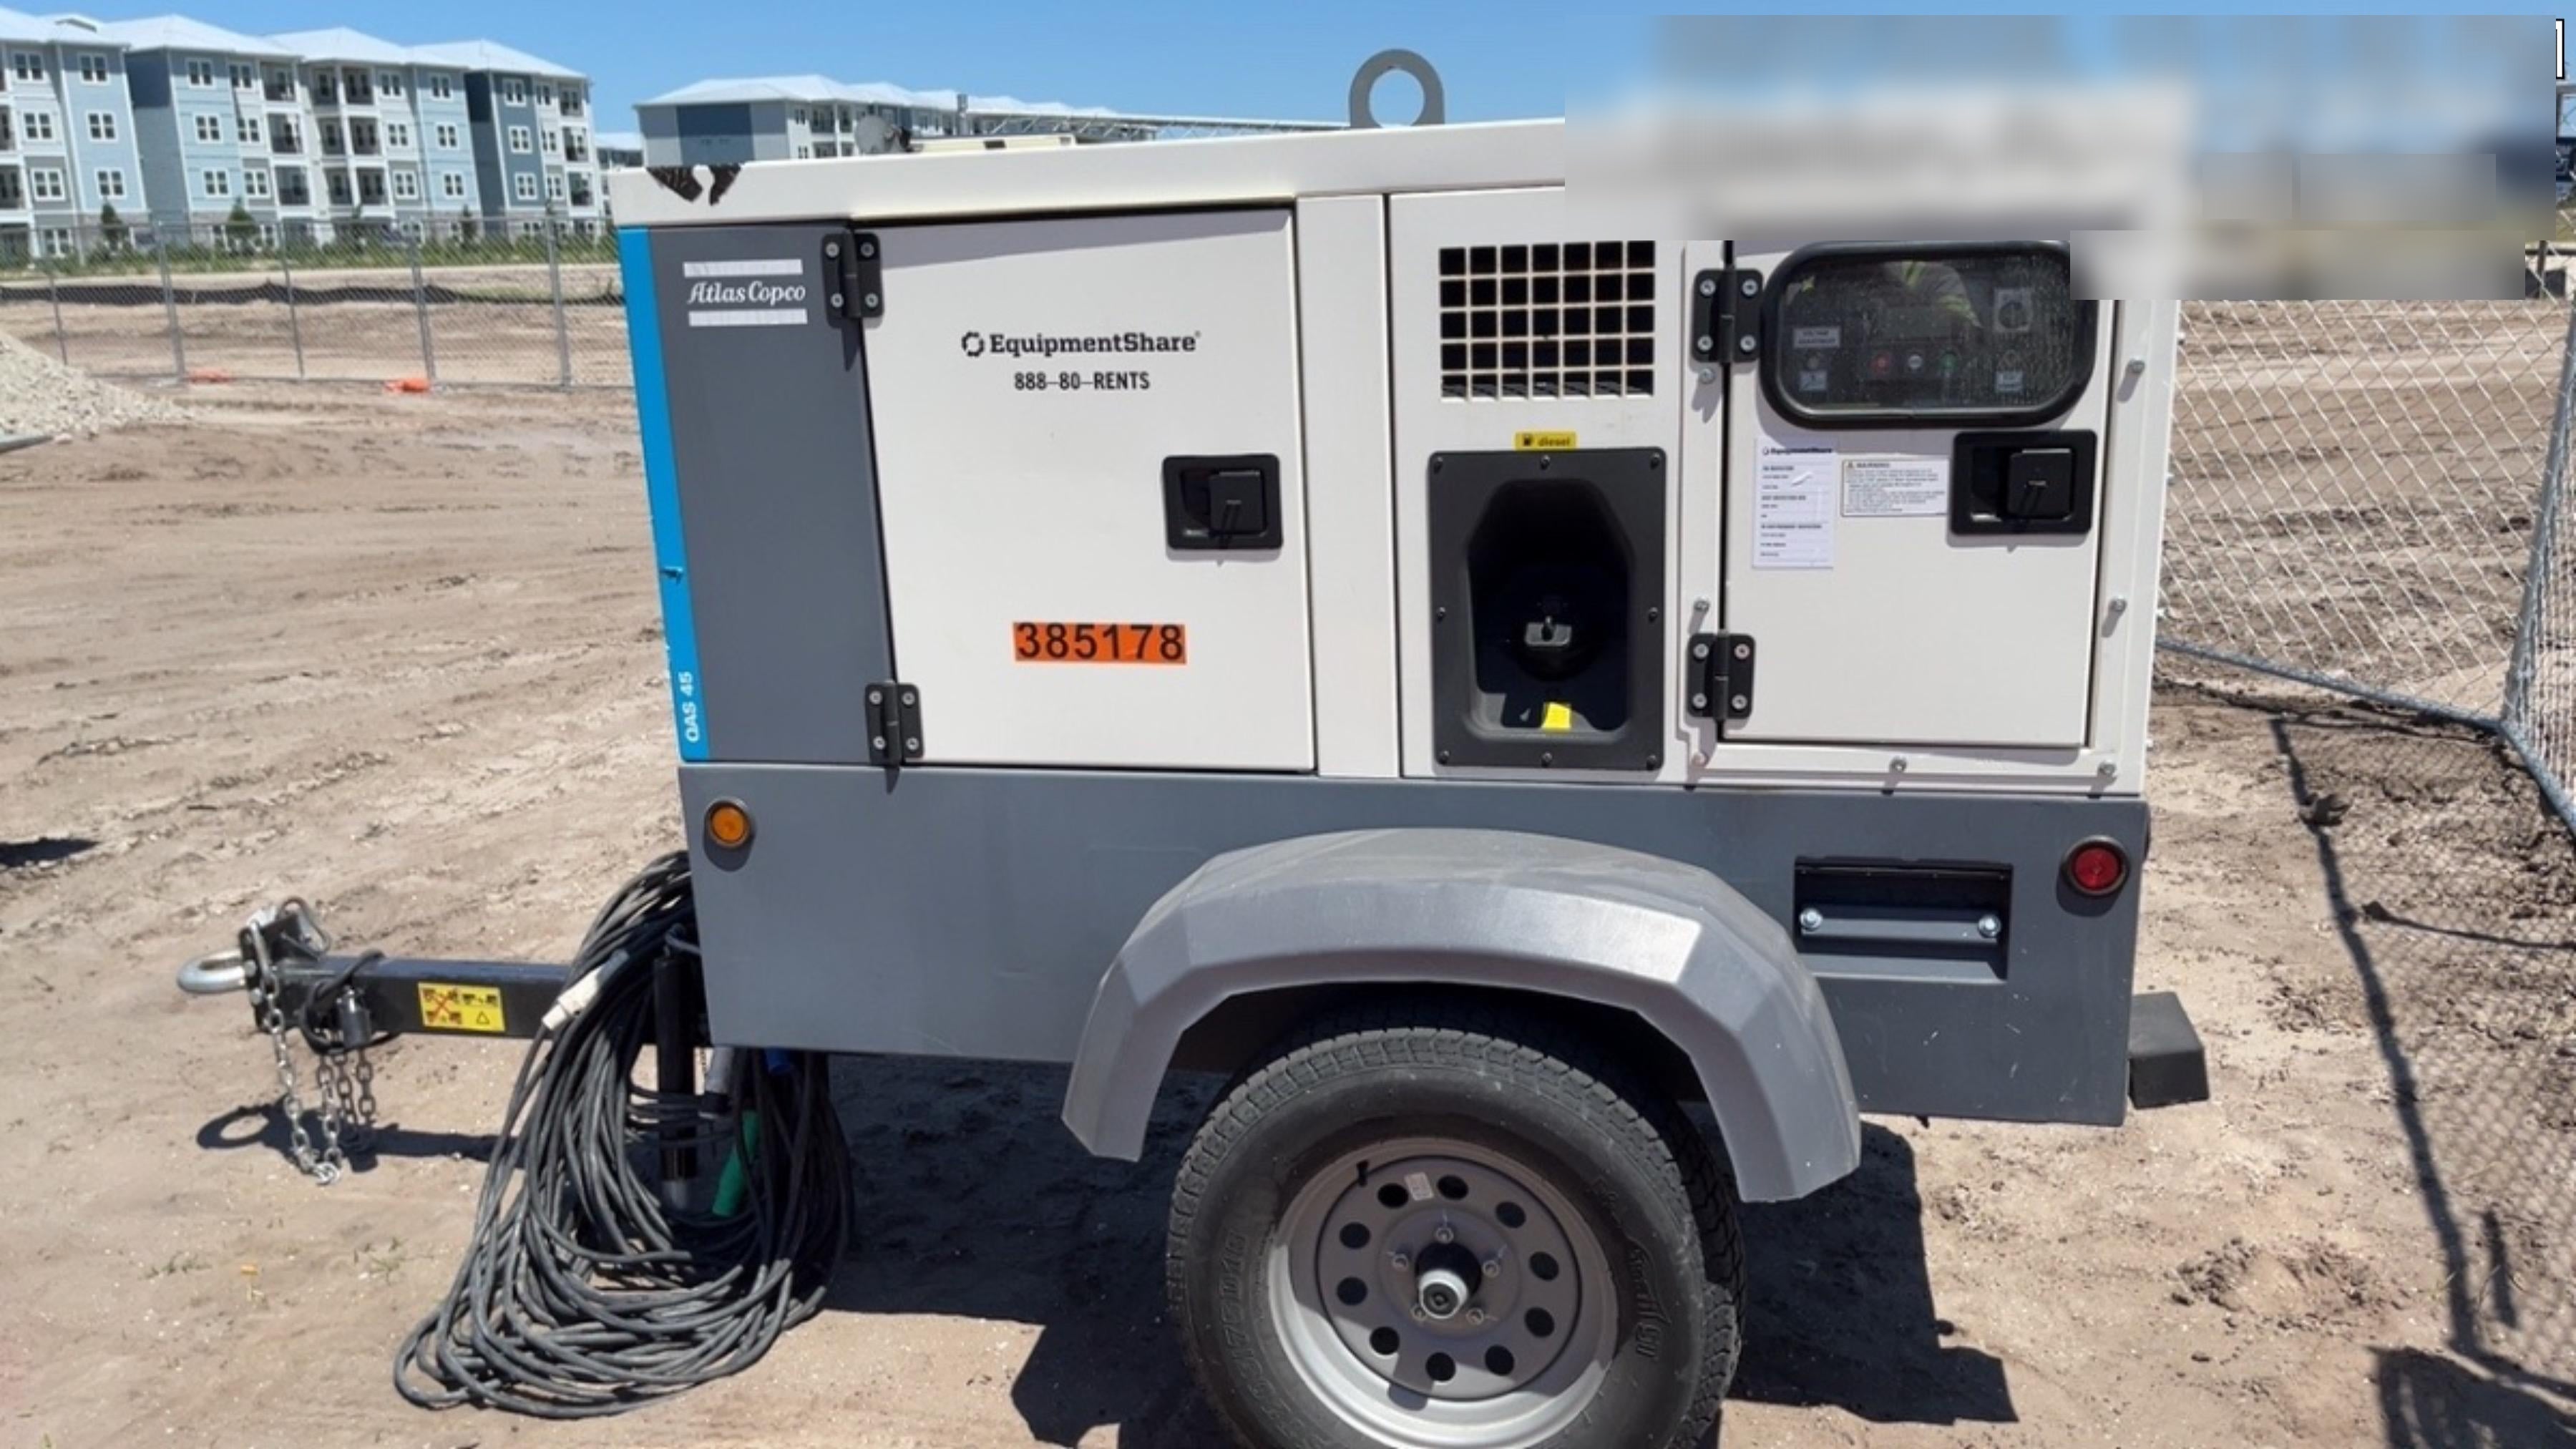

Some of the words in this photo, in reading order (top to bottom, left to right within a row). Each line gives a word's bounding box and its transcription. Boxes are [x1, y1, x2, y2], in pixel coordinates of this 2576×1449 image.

[687, 280, 746, 303] Atlas
[748, 280, 806, 306] Copco
[989, 331, 1198, 357] EquipmentShare
[1013, 371, 1151, 391] 888-80-RENTS
[1016, 622, 1184, 660] 385178
[678, 670, 694, 698] 45
[681, 701, 700, 743] QAS
